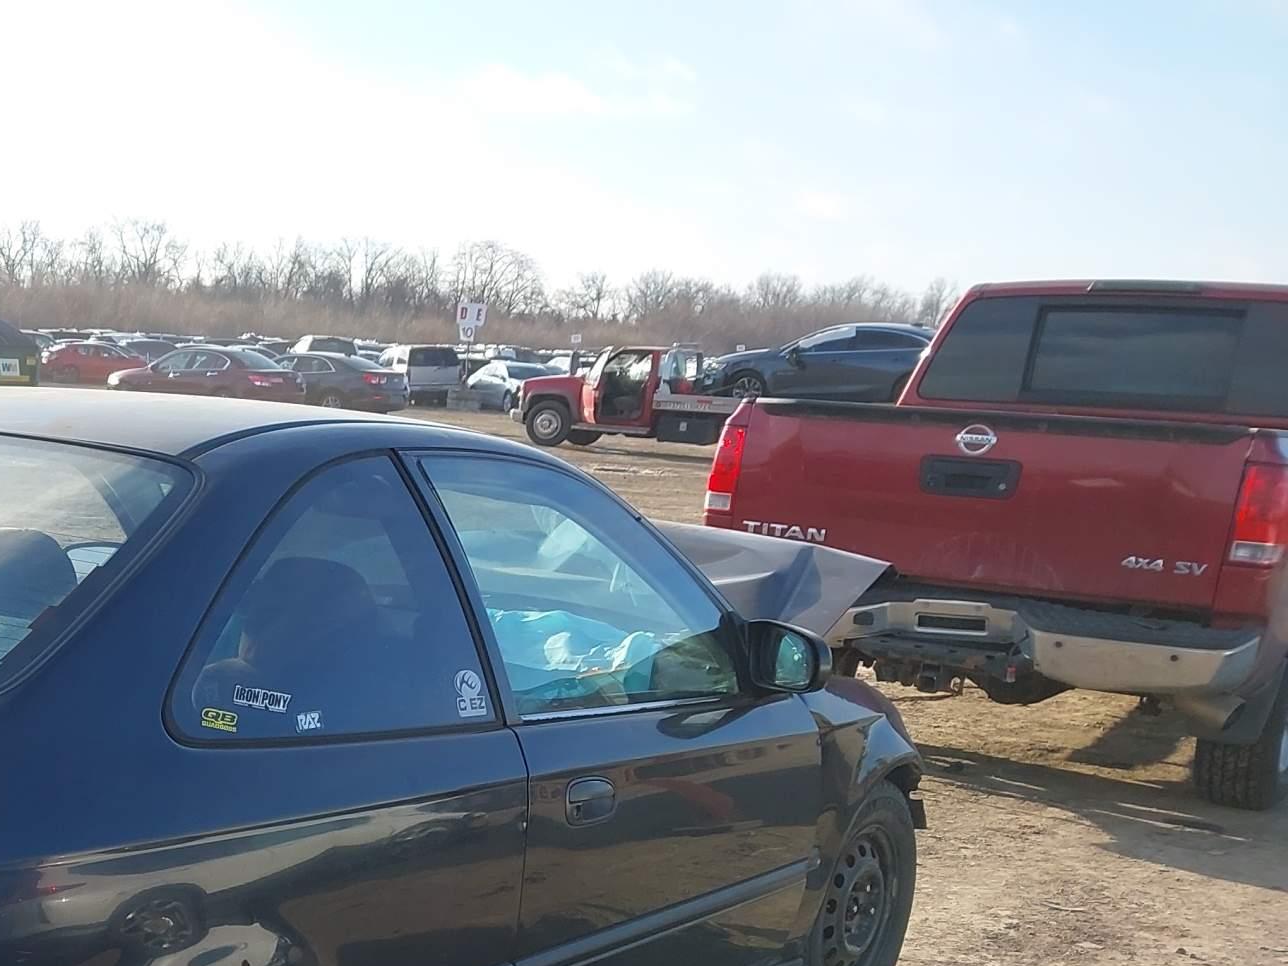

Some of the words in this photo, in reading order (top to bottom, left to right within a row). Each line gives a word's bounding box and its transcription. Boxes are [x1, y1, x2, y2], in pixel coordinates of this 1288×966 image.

[460, 307, 468, 320] D
[476, 308, 483, 321] E
[742, 520, 826, 542] TITAN
[1173, 561, 1208, 576] SV
[235, 686, 261, 705] IRON
[262, 690, 290, 710] PONY
